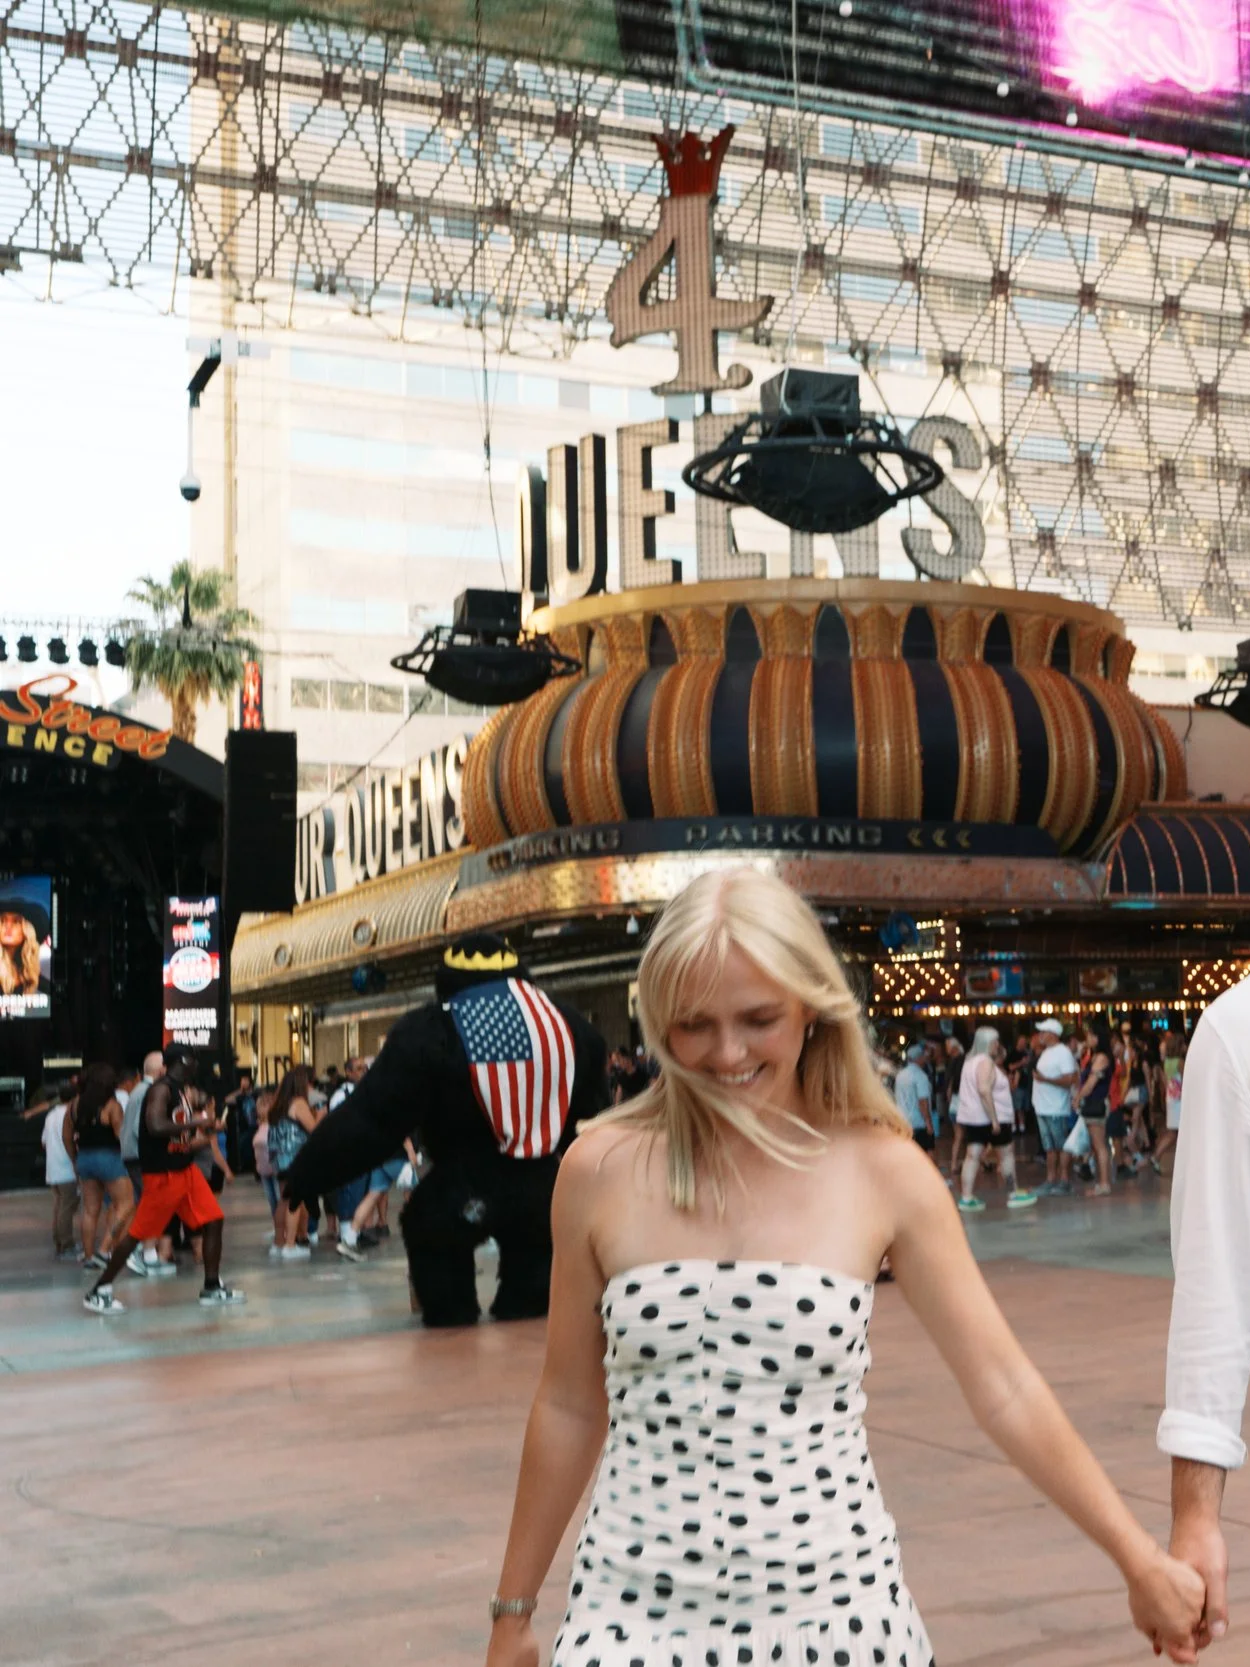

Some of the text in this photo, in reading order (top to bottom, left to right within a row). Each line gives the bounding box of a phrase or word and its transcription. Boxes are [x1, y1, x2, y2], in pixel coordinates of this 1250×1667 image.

[606, 194, 776, 396] 4
[0, 673, 172, 761] Street
[294, 732, 471, 906] UR QUEENS
[684, 823, 883, 846] PARKING
